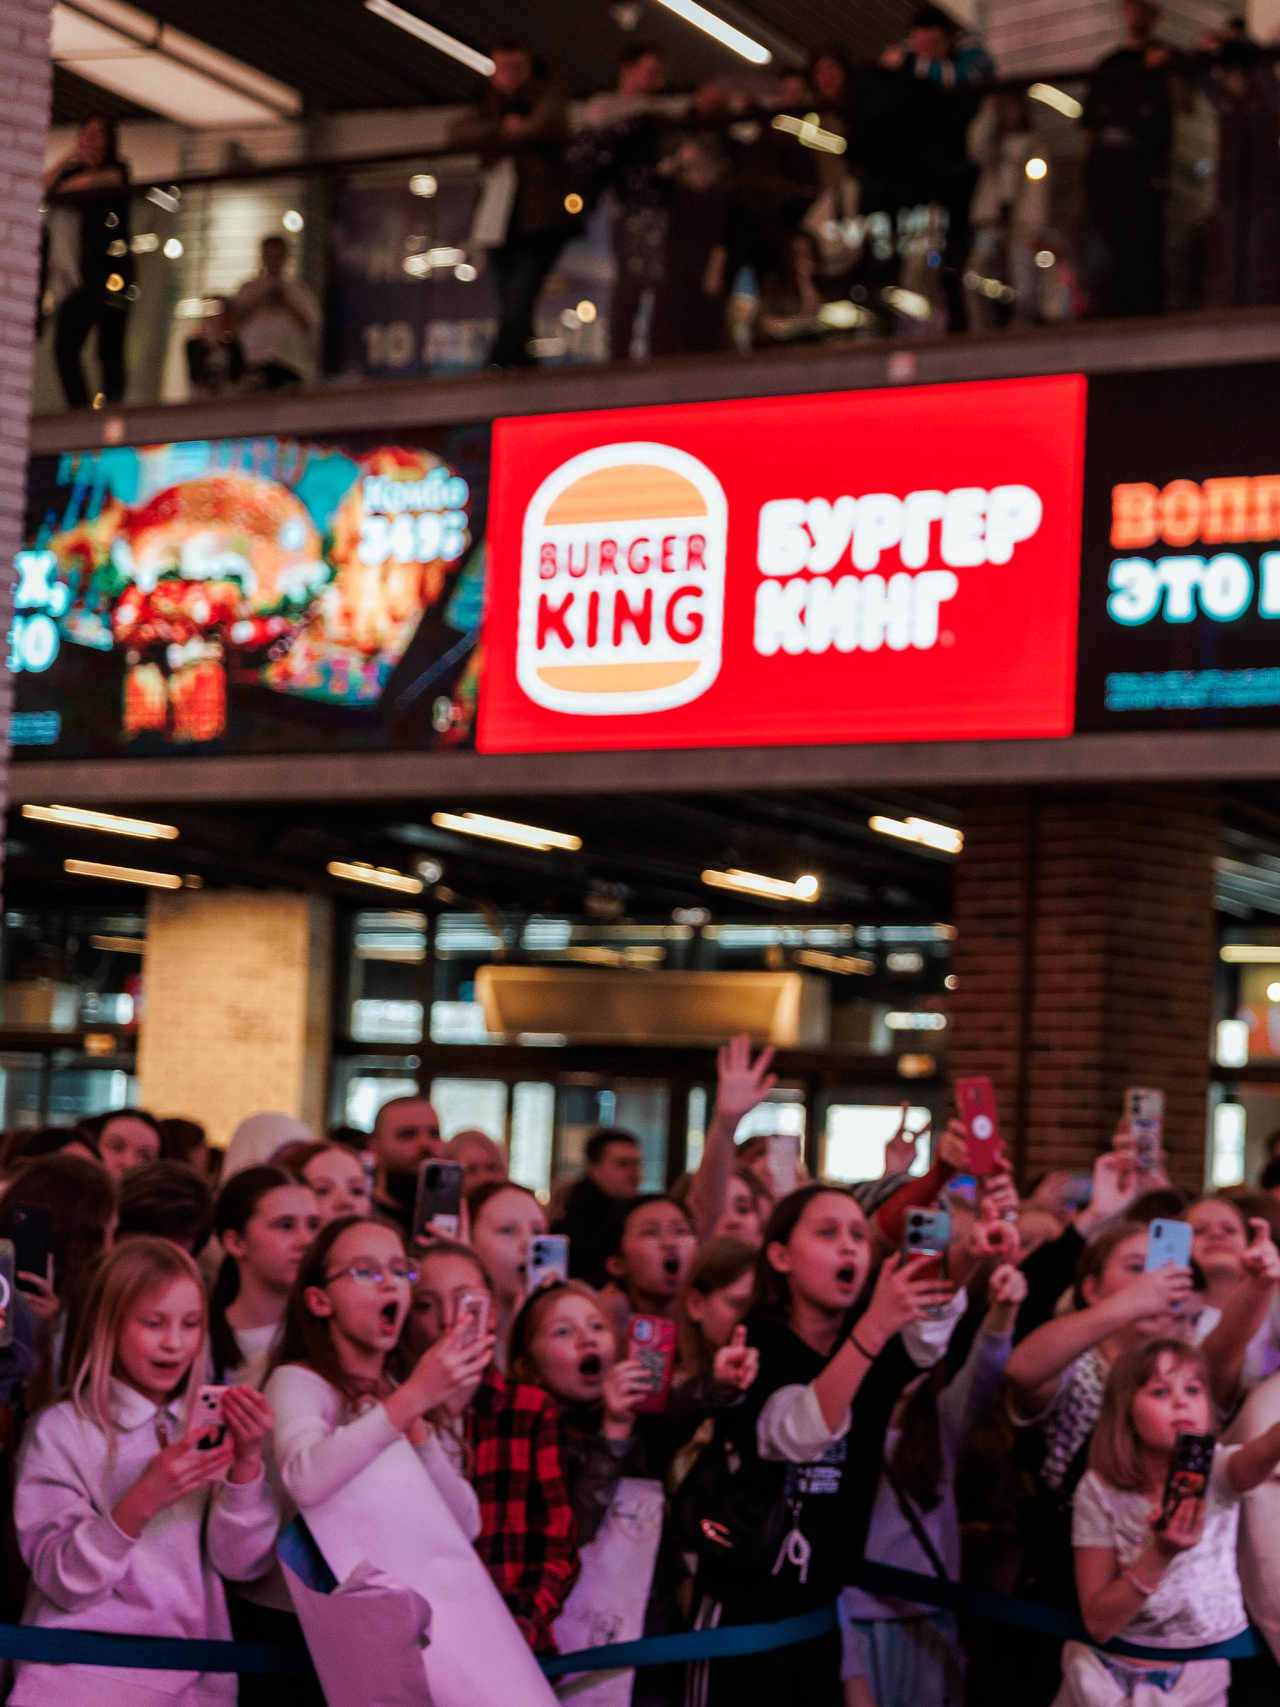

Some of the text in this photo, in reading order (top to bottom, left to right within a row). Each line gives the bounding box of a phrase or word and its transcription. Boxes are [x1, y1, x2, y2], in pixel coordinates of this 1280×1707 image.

[539, 534, 707, 579] BURGER
[757, 484, 1043, 576] БУРГЕР
[535, 585, 704, 650] KING
[753, 570, 958, 656] КИНГ
[1107, 553, 1253, 625] ЭТО
